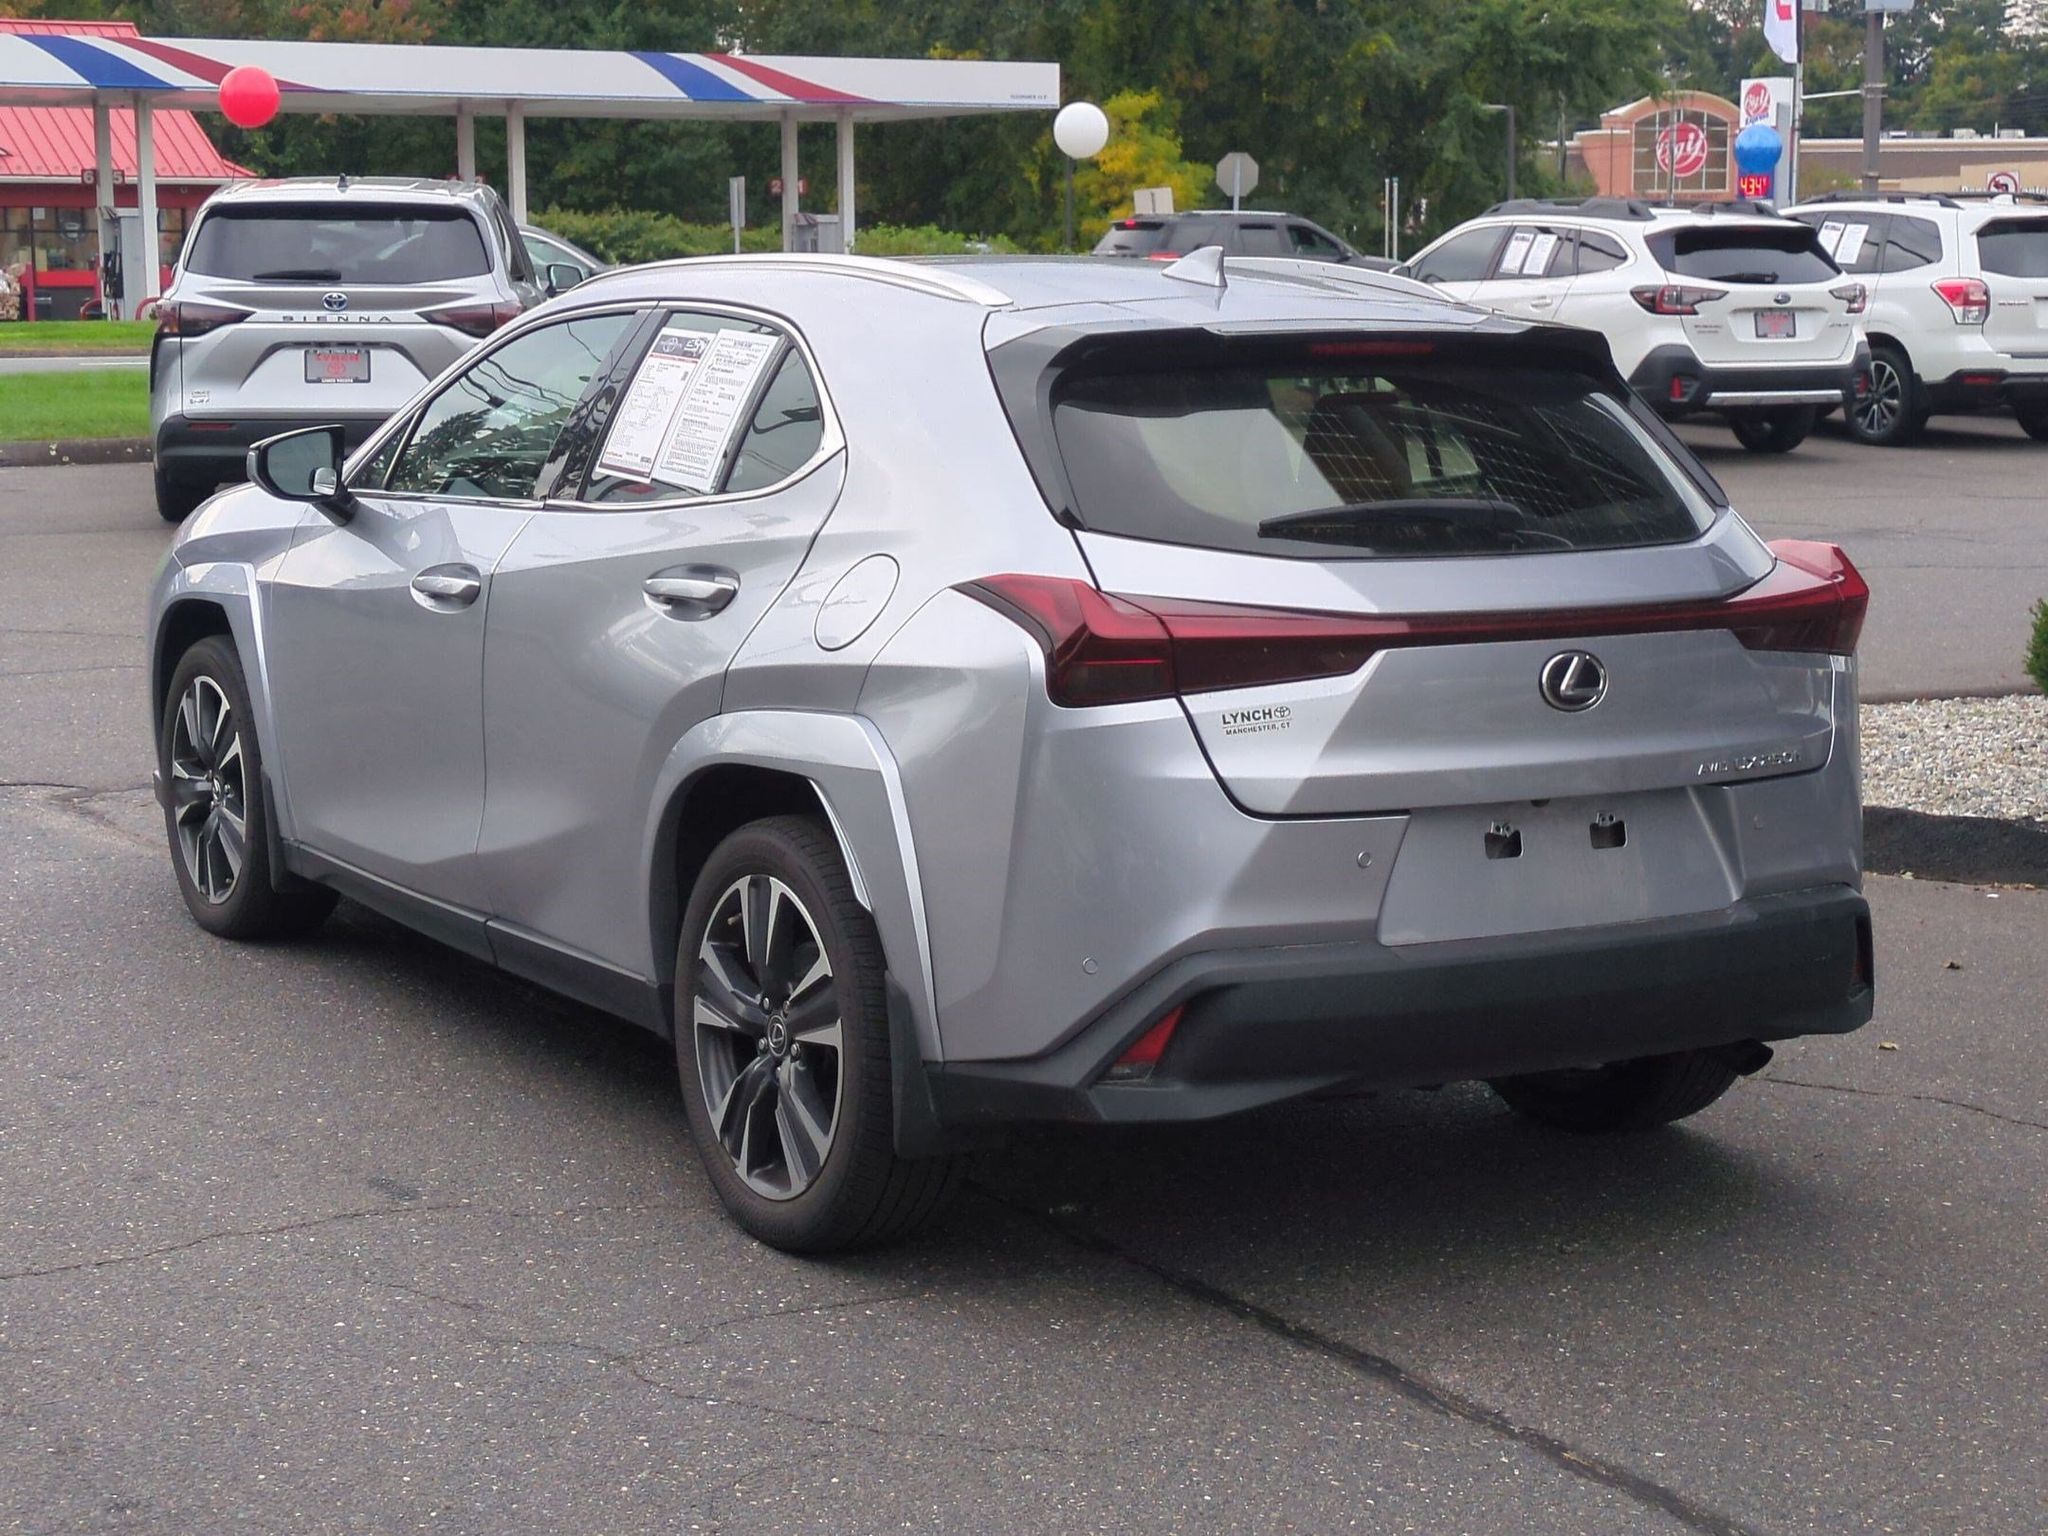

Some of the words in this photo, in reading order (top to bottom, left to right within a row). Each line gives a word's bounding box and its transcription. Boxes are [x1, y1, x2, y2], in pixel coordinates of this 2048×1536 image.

[83, 171, 94, 184] 6
[112, 171, 123, 184] 5
[282, 315, 392, 323] SIENNA
[1222, 708, 1273, 725] LYNCH
[1225, 723, 1279, 736] MANCHESTER,
[1280, 721, 1290, 729] CT
